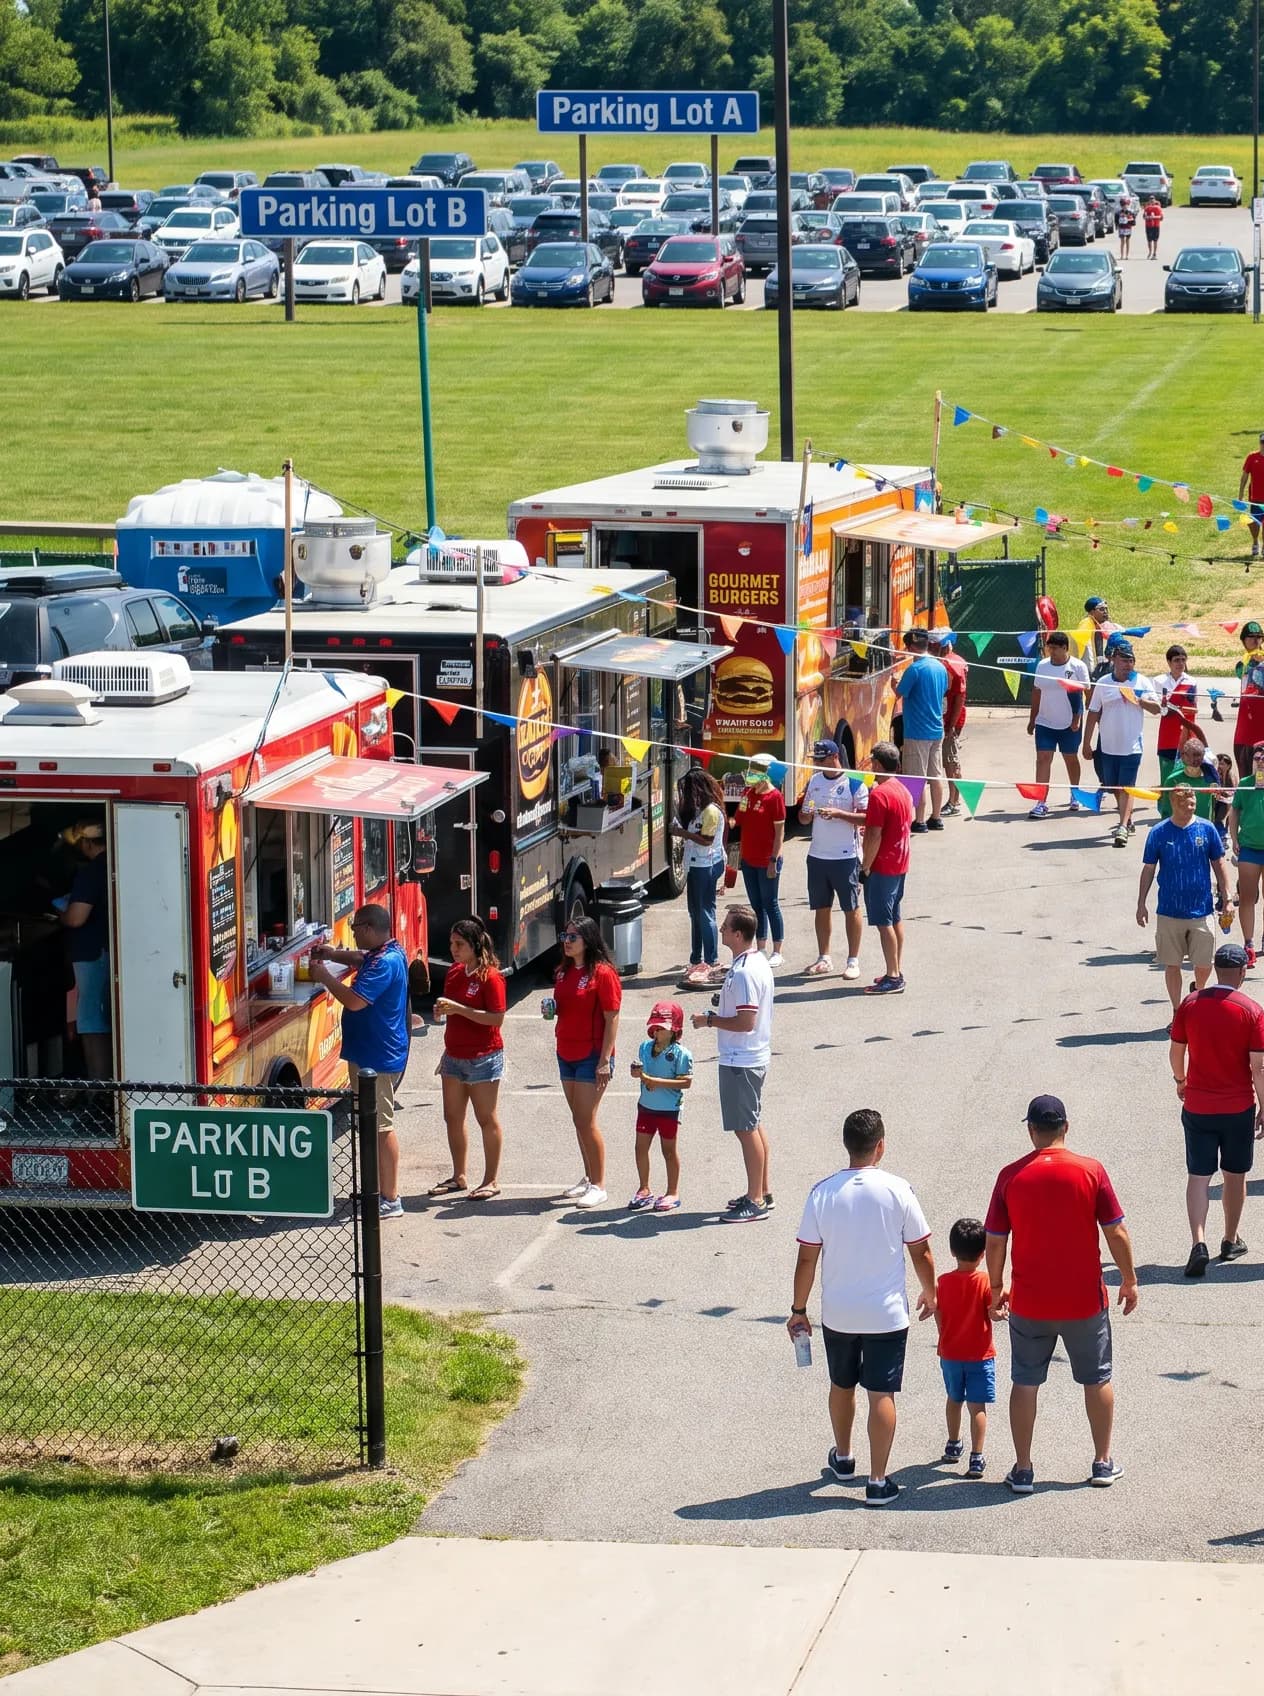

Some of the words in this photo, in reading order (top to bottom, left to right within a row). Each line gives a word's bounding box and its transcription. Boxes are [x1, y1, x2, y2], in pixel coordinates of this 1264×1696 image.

[553, 96, 659, 131] Parking
[670, 97, 713, 125] Lot
[722, 97, 742, 125] A
[258, 196, 376, 234] Parking
[387, 196, 436, 227] Lot
[448, 197, 467, 227] B
[709, 572, 780, 589] GOURMET
[709, 589, 780, 605] BURGERS
[149, 1121, 313, 1158] PARKING
[248, 1167, 271, 1199] B
